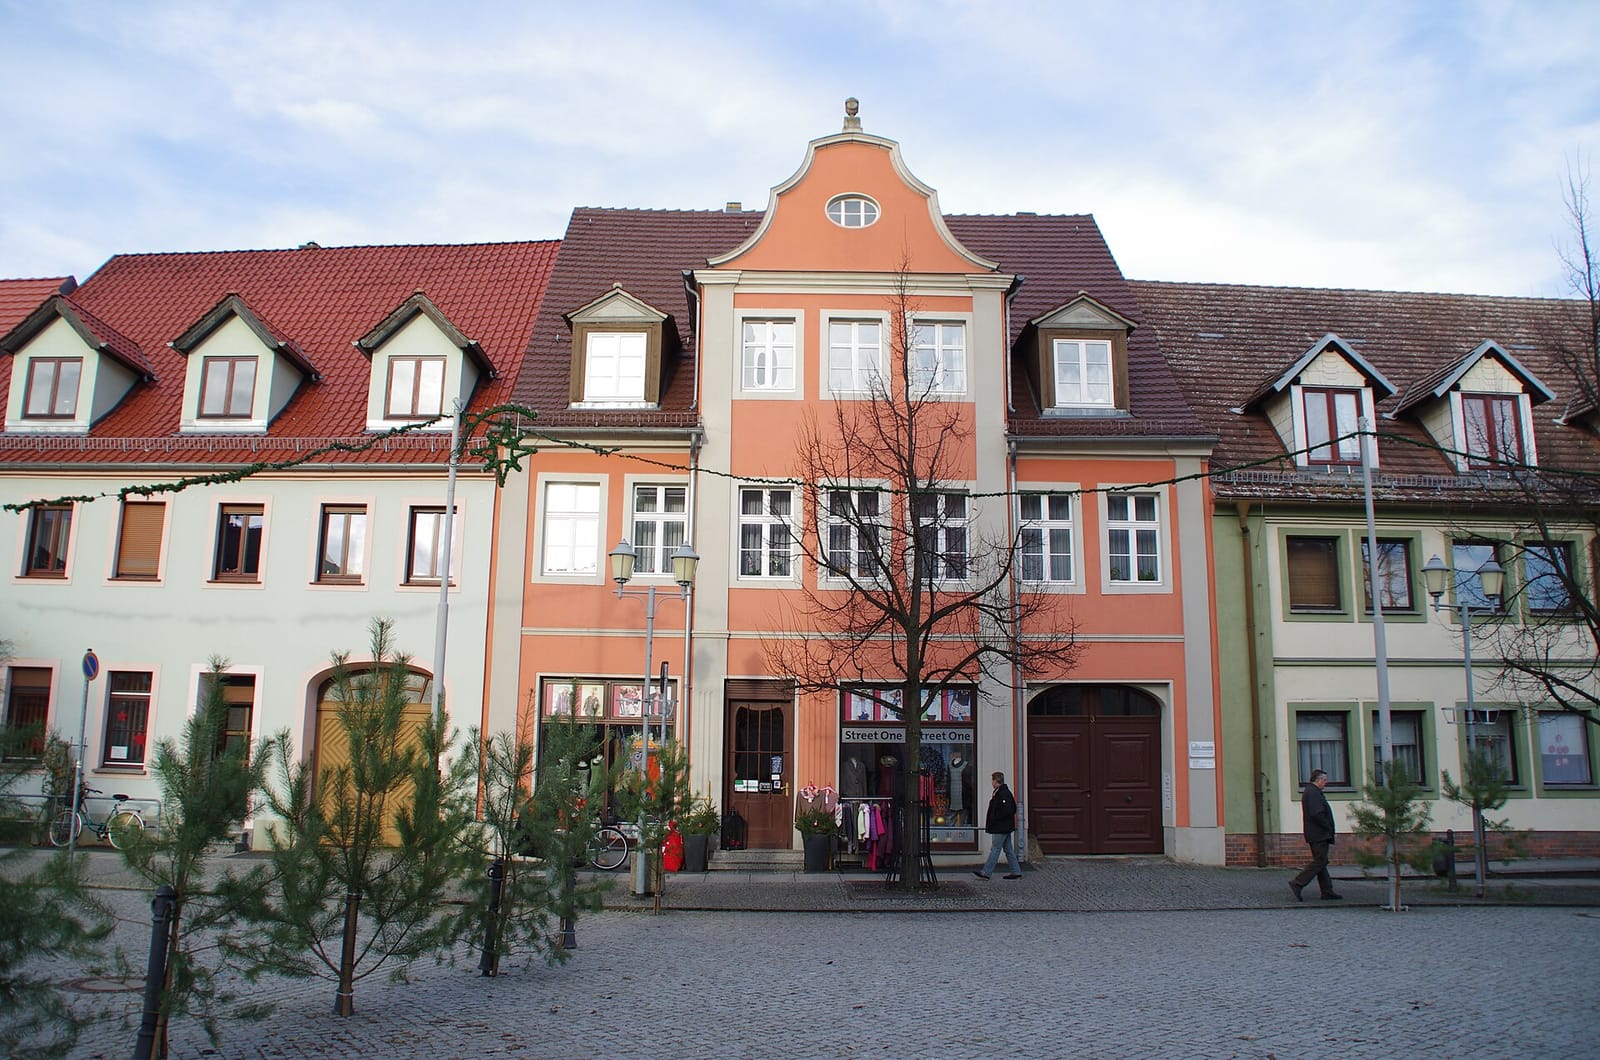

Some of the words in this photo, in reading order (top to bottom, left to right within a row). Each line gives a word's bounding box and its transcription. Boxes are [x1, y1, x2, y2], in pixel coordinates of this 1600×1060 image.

[845, 730, 879, 740] Street
[880, 731, 902, 740] One
[920, 731, 946, 741] treet
[948, 731, 970, 741] One
